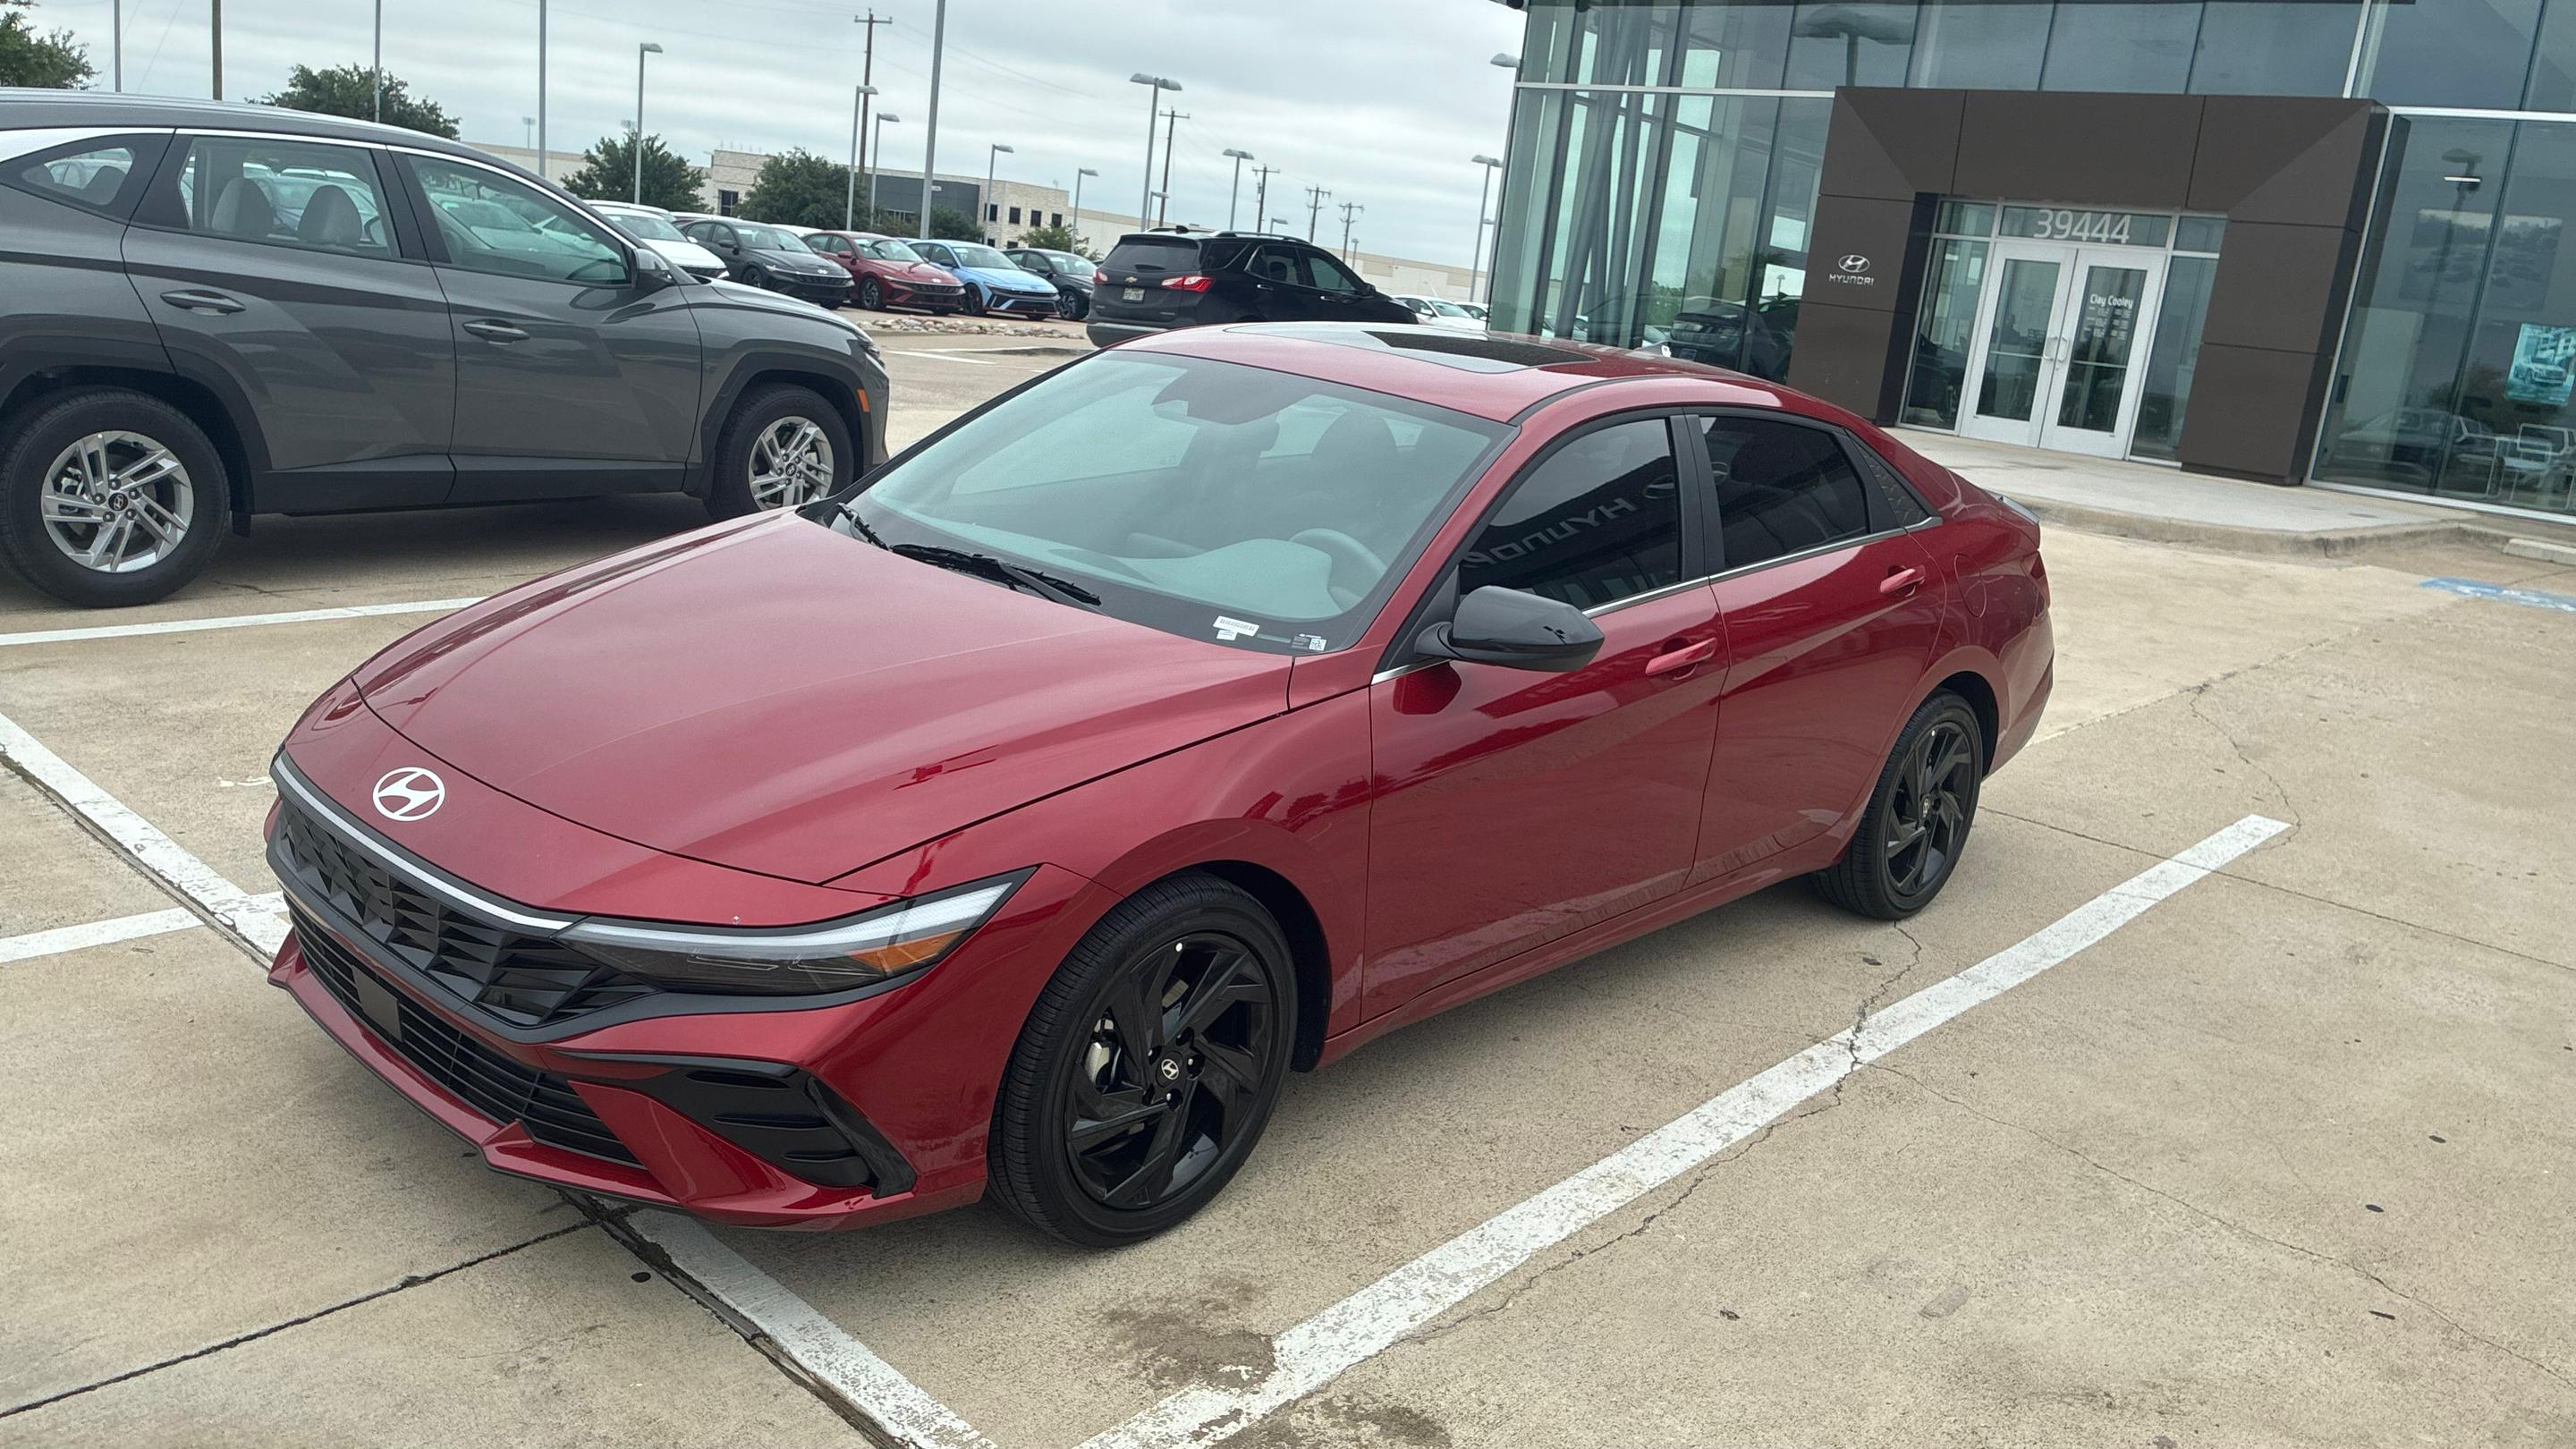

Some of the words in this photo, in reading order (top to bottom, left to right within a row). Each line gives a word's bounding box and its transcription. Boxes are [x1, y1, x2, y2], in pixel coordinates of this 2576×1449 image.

[2033, 209, 2131, 244] 39444
[1828, 273, 1875, 286] HYUNDAI
[2089, 293, 2106, 307] Clay
[2107, 294, 2133, 309] Cooley
